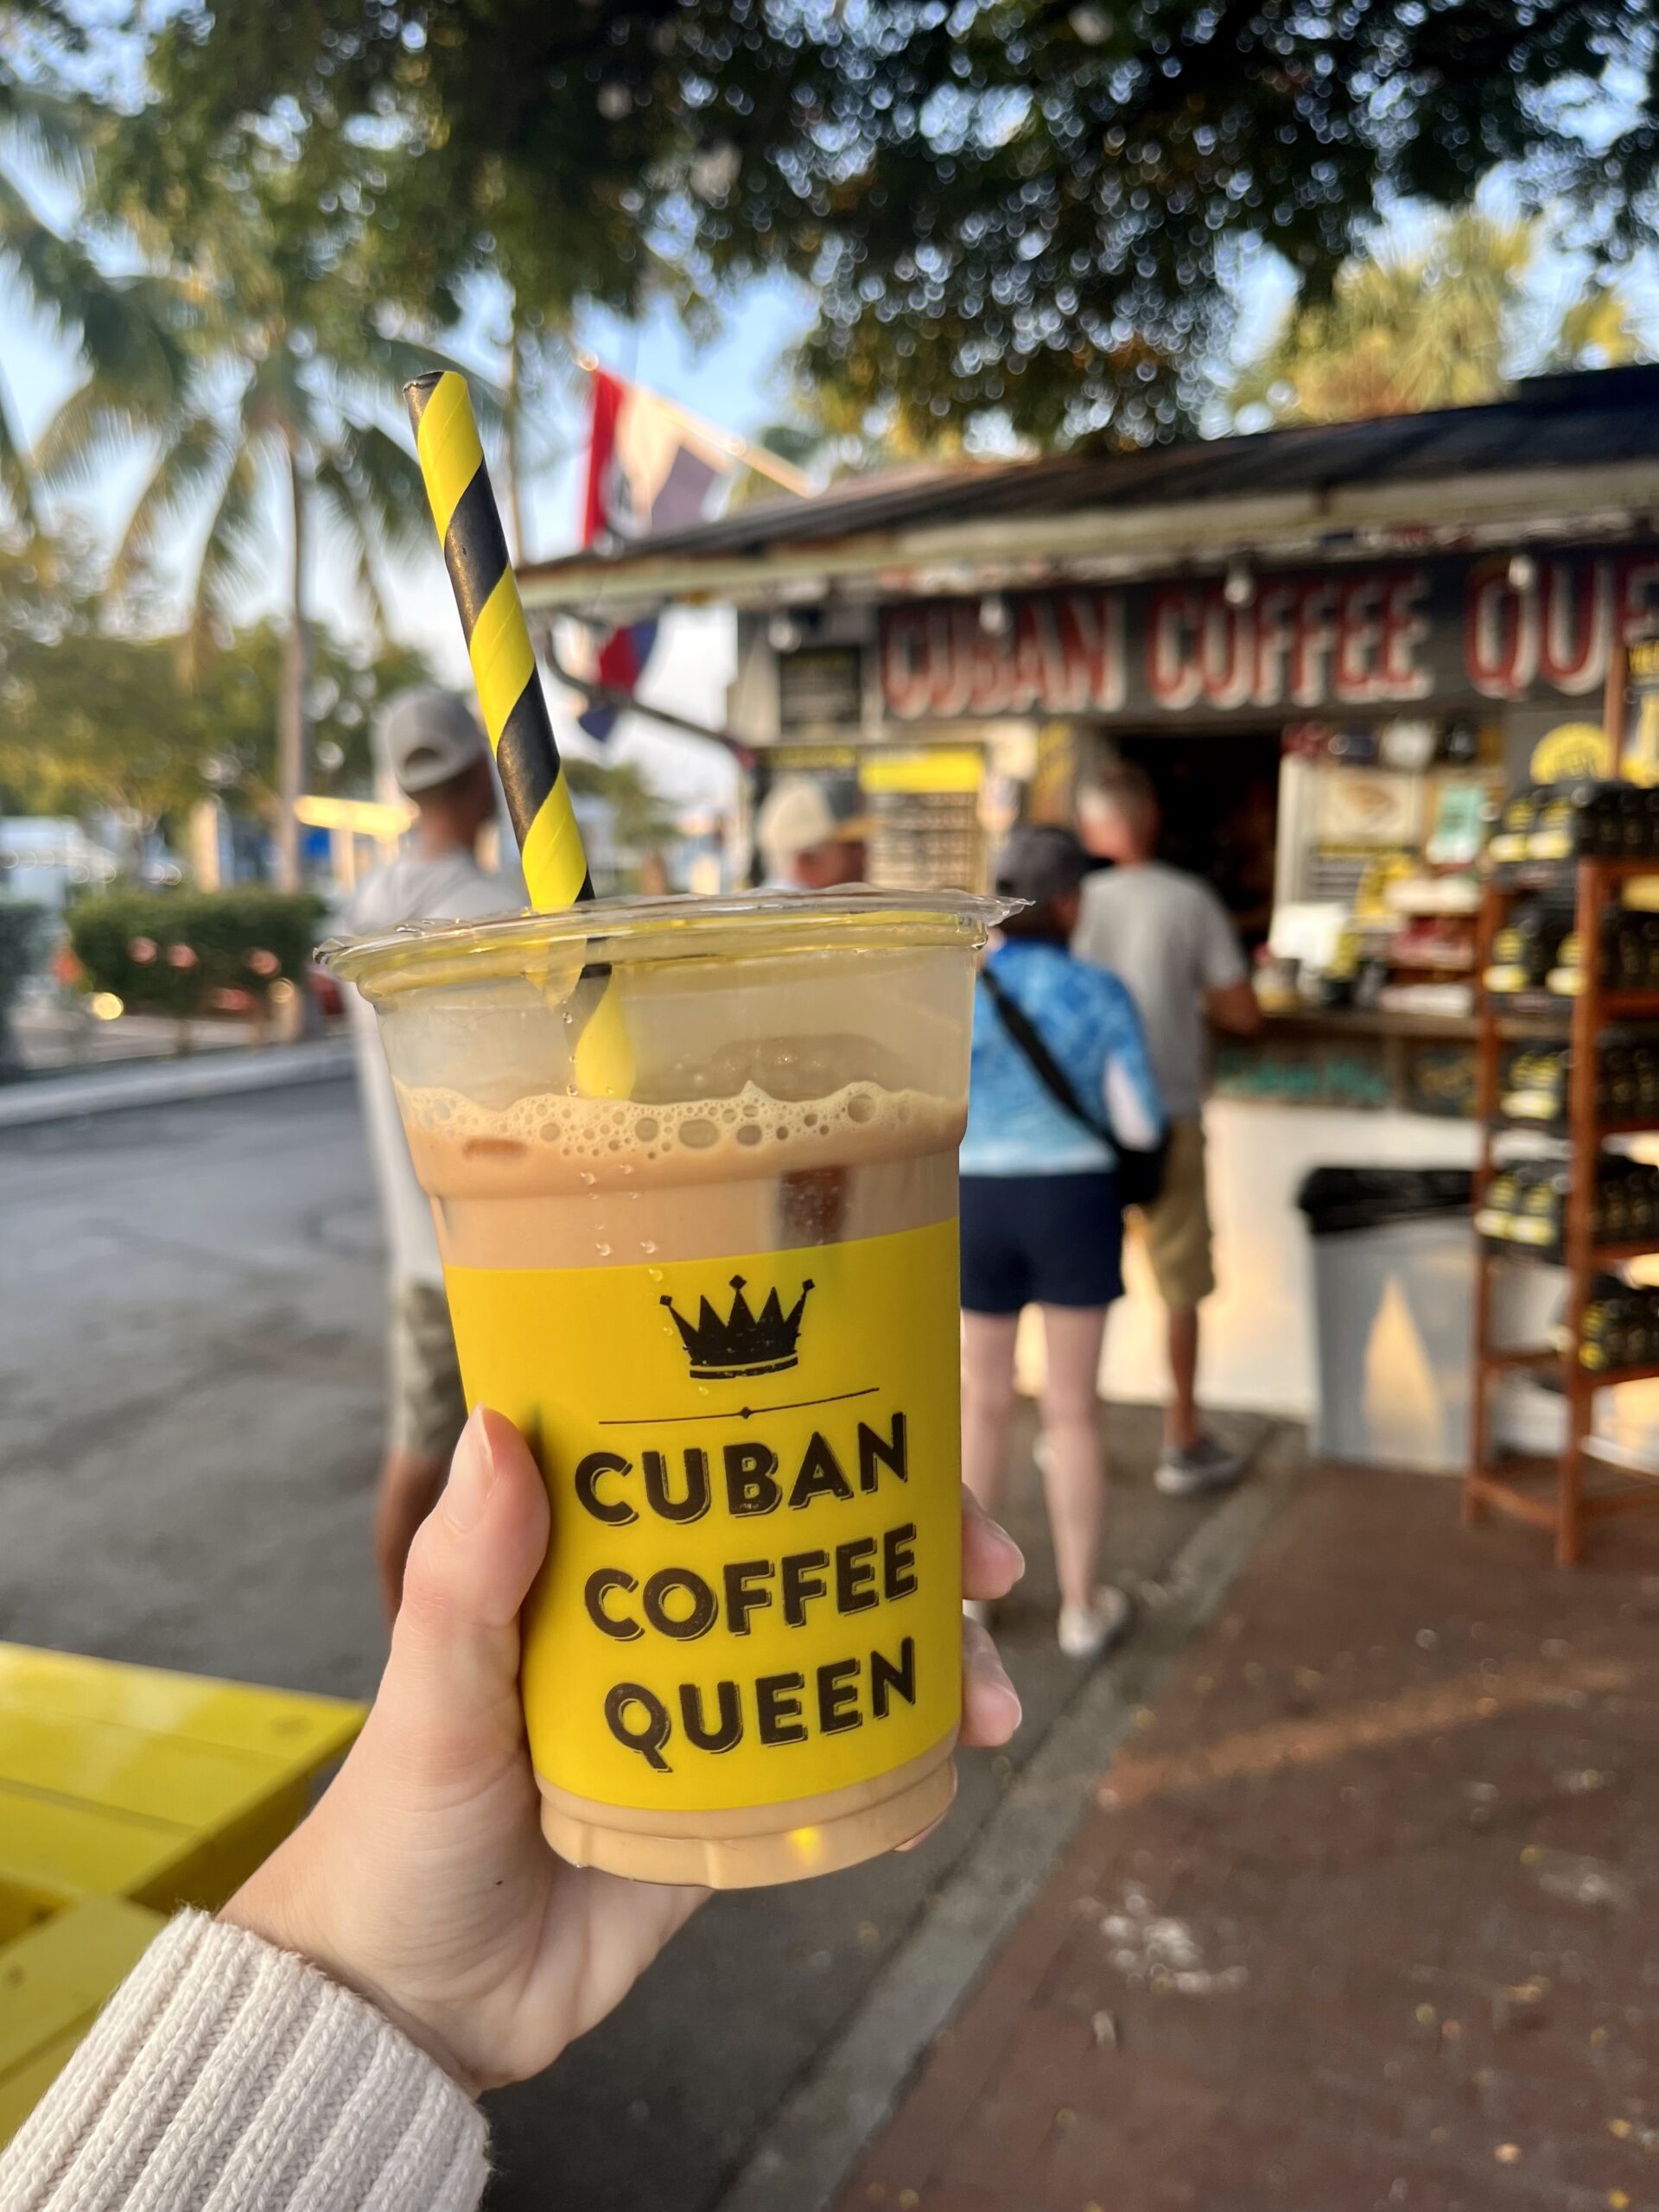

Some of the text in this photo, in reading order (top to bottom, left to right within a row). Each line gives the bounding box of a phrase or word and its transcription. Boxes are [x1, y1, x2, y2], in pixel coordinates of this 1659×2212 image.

[880, 596, 1127, 719] CUBAN
[1146, 558, 1438, 711] COFFEE
[574, 1411, 909, 1527] CUBAN
[583, 1522, 918, 1642] COFFEE
[603, 1636, 917, 1774] QUEEN
